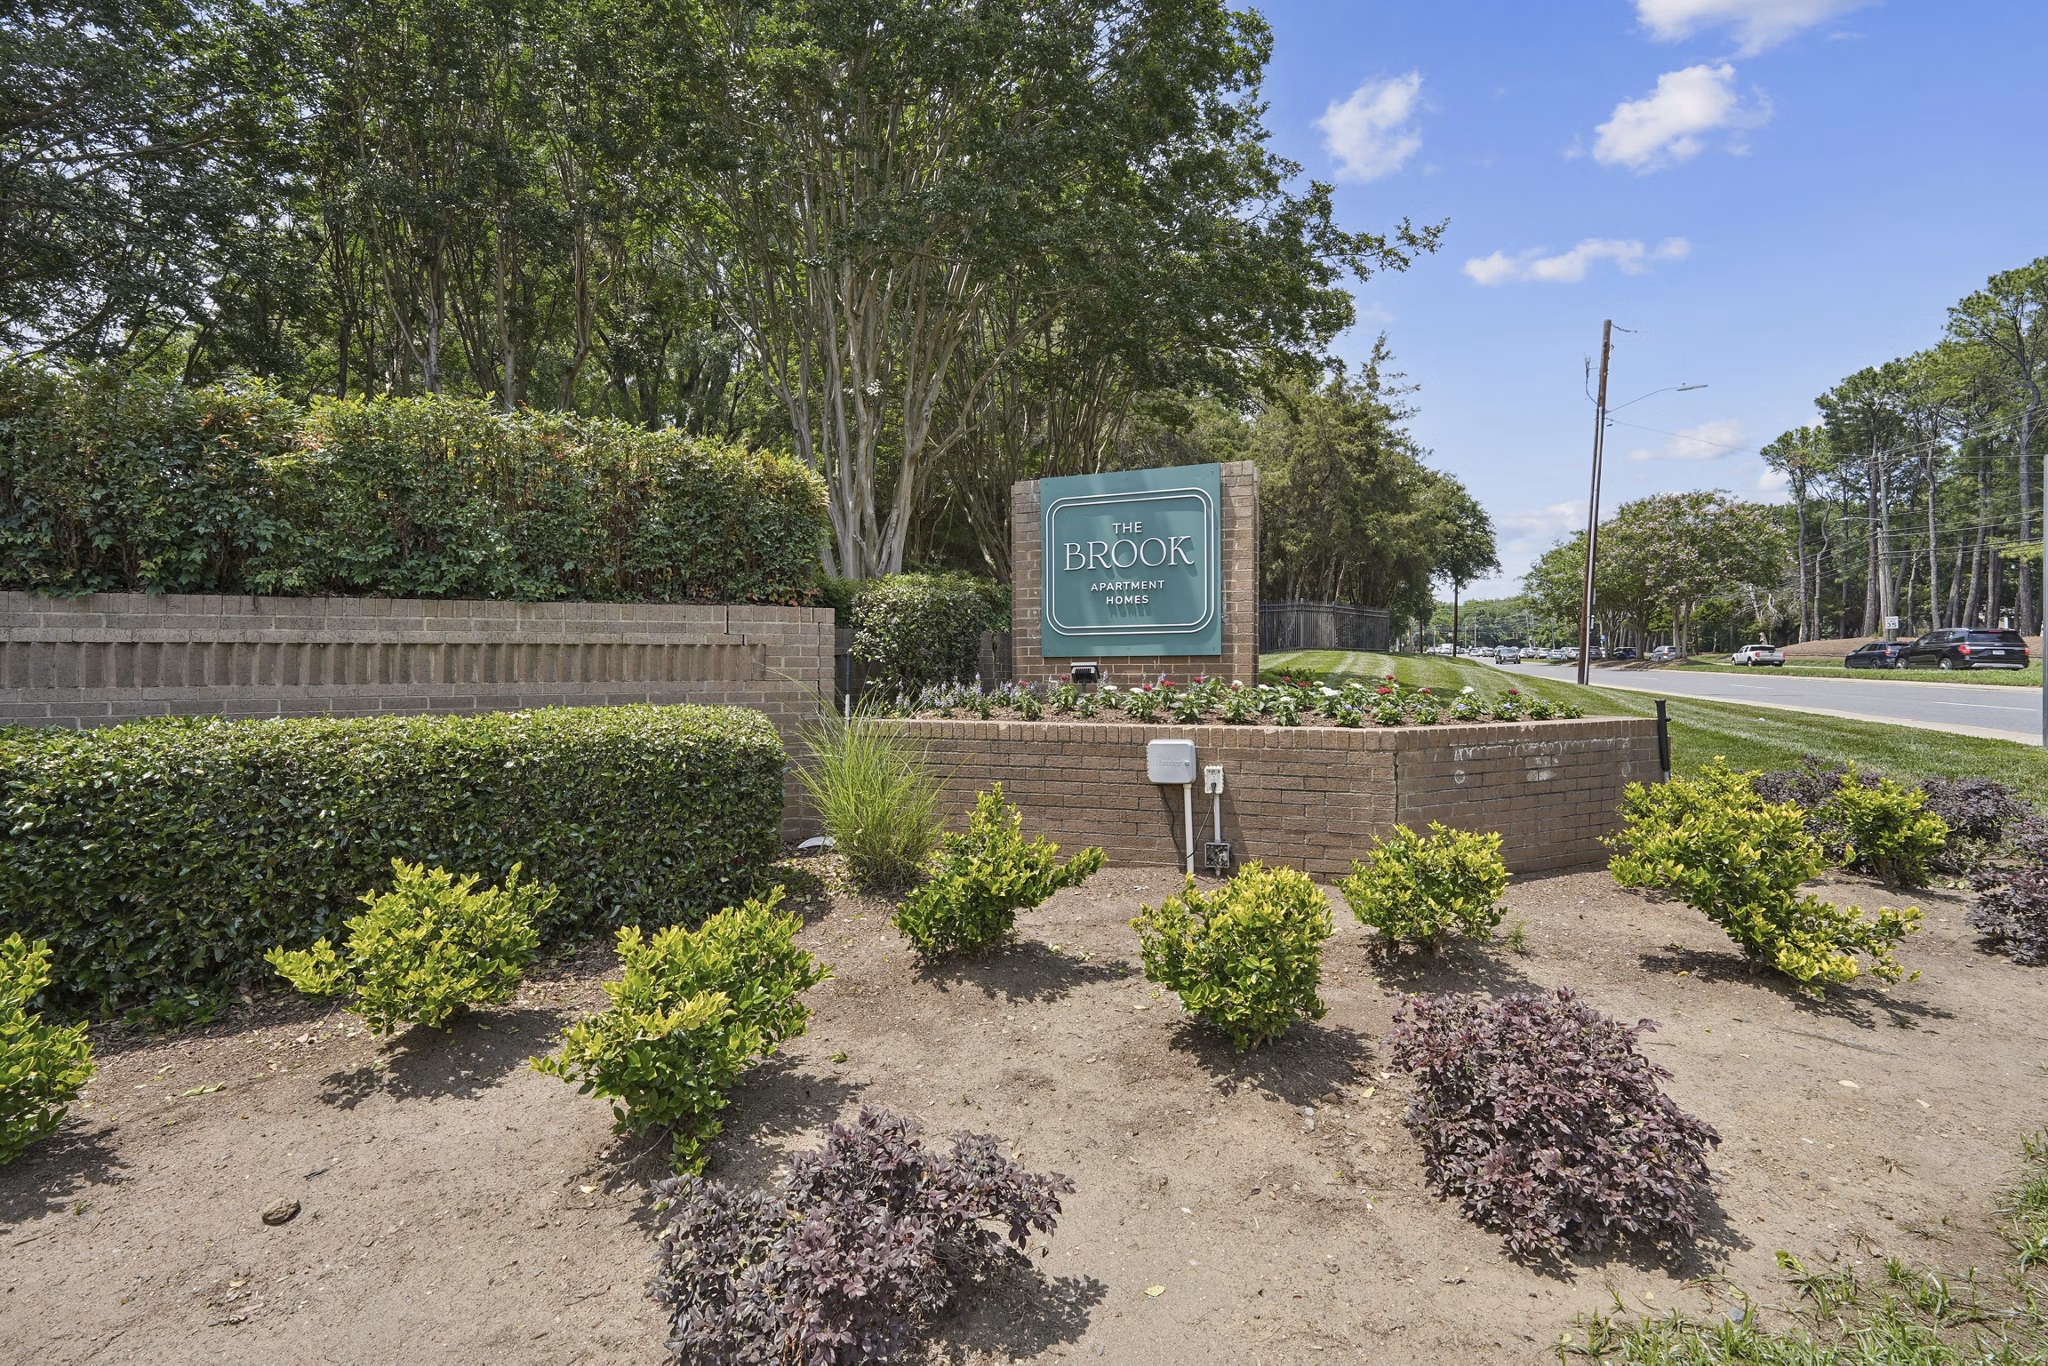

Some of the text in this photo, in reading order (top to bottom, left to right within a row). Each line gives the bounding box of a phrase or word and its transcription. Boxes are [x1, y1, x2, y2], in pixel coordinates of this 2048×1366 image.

[1112, 521, 1143, 534] THE
[1064, 536, 1194, 571] BROOK
[1091, 580, 1165, 592] APARTMENT
[1106, 595, 1149, 605] HOMES
